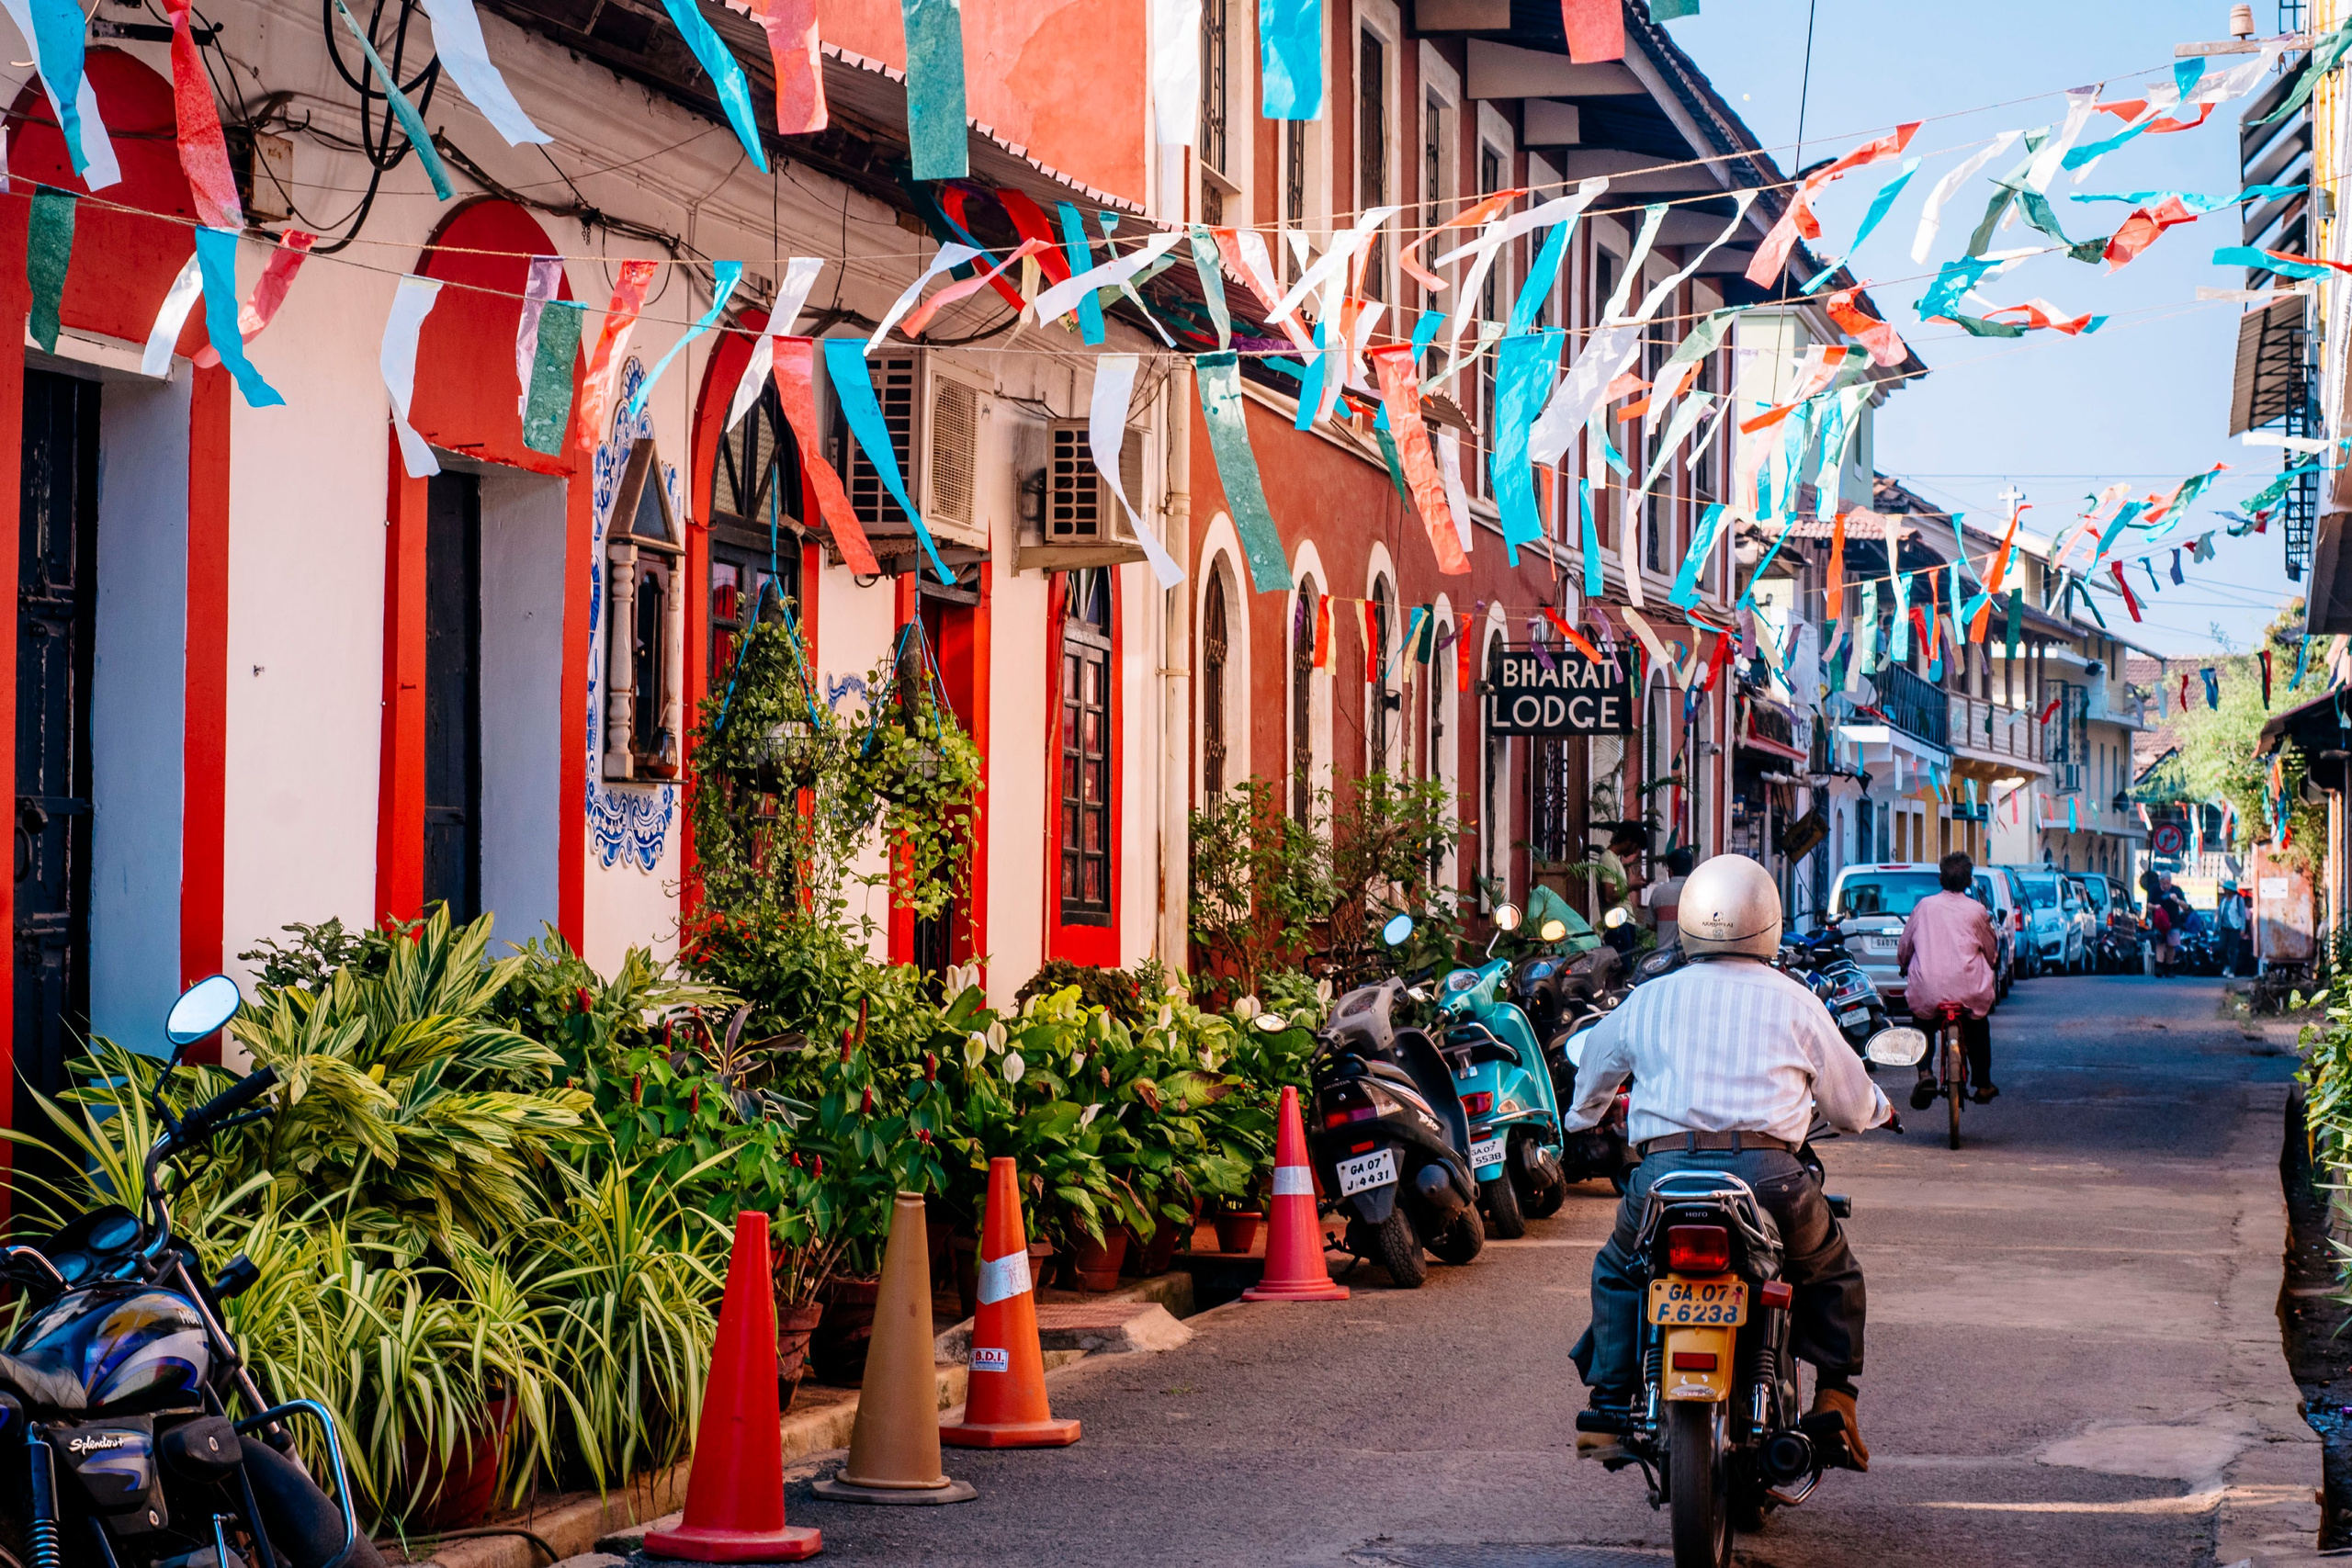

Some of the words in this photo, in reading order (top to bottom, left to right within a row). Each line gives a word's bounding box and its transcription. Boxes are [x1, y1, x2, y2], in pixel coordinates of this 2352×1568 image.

[1503, 659, 1615, 689] BHARAT
[1492, 695, 1620, 728] LODGE
[1323, 1079, 1351, 1090] HONDA
[976, 1350, 1005, 1362] B.D.I.
